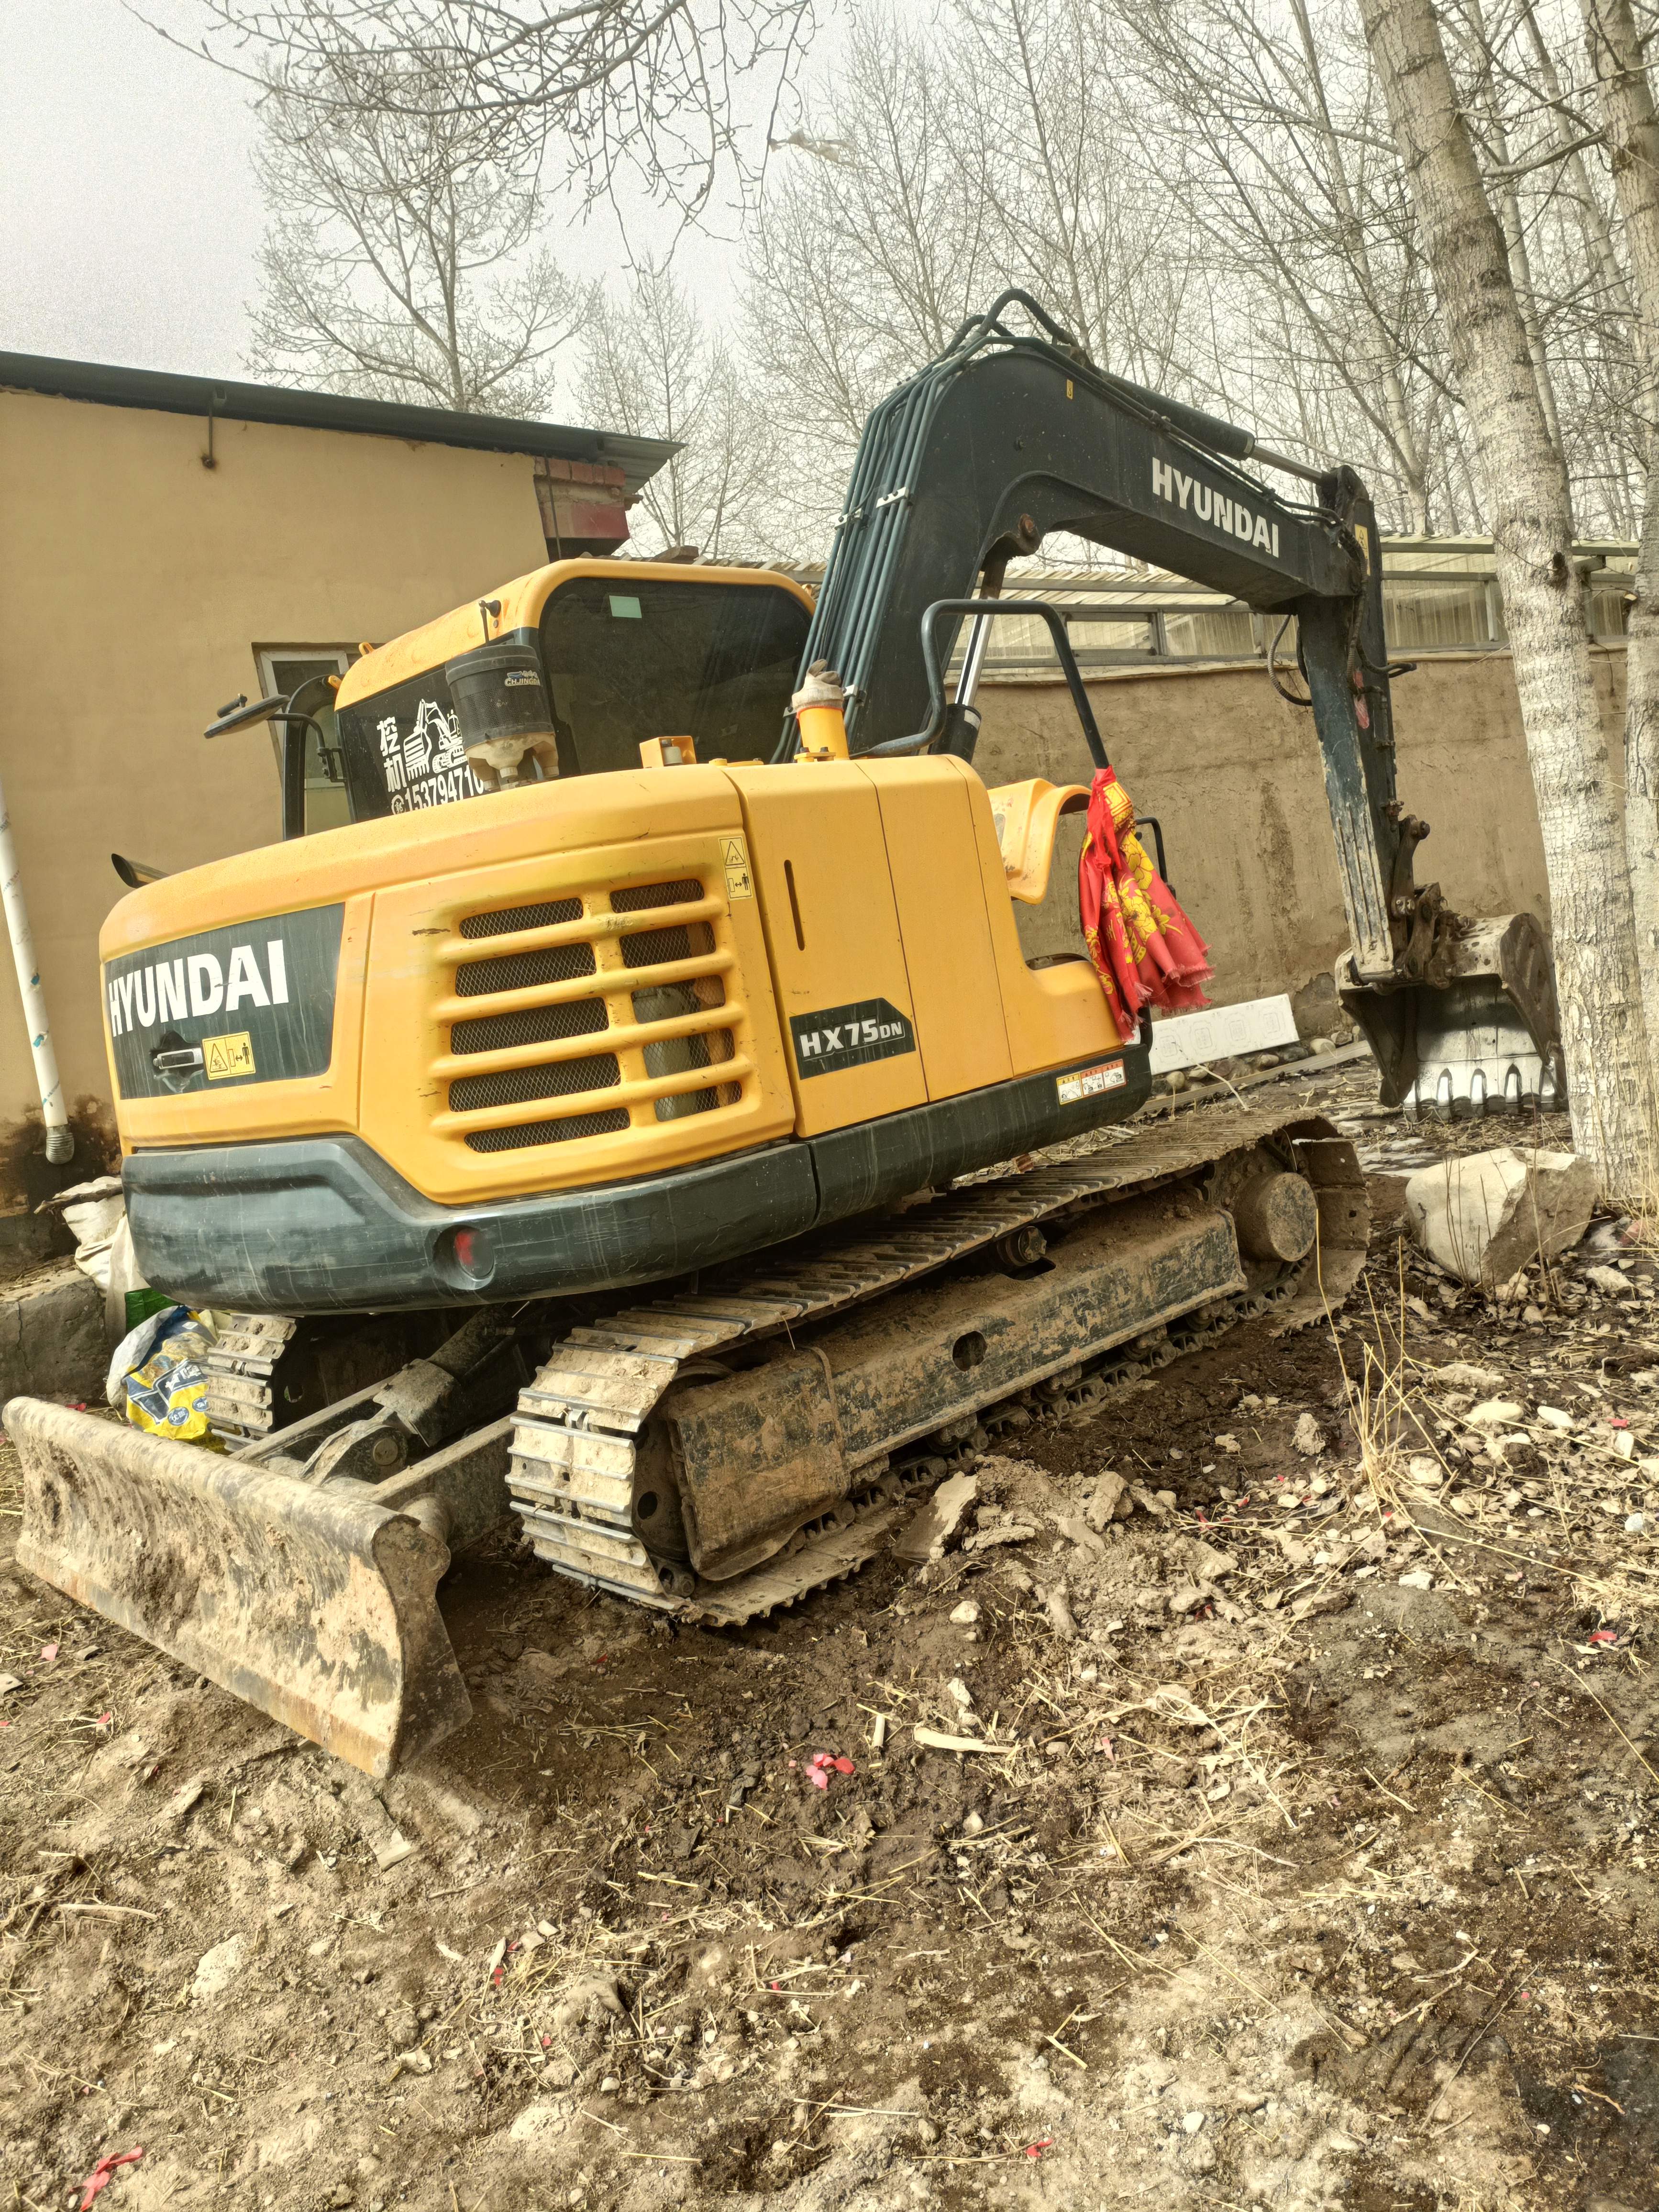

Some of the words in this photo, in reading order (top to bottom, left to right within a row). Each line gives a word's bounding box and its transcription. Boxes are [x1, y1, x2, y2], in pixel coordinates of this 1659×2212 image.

[1152, 457, 1279, 558] HYUNDAI
[376, 717, 407, 793] 挖机
[109, 939, 289, 1037] HYUNDAI
